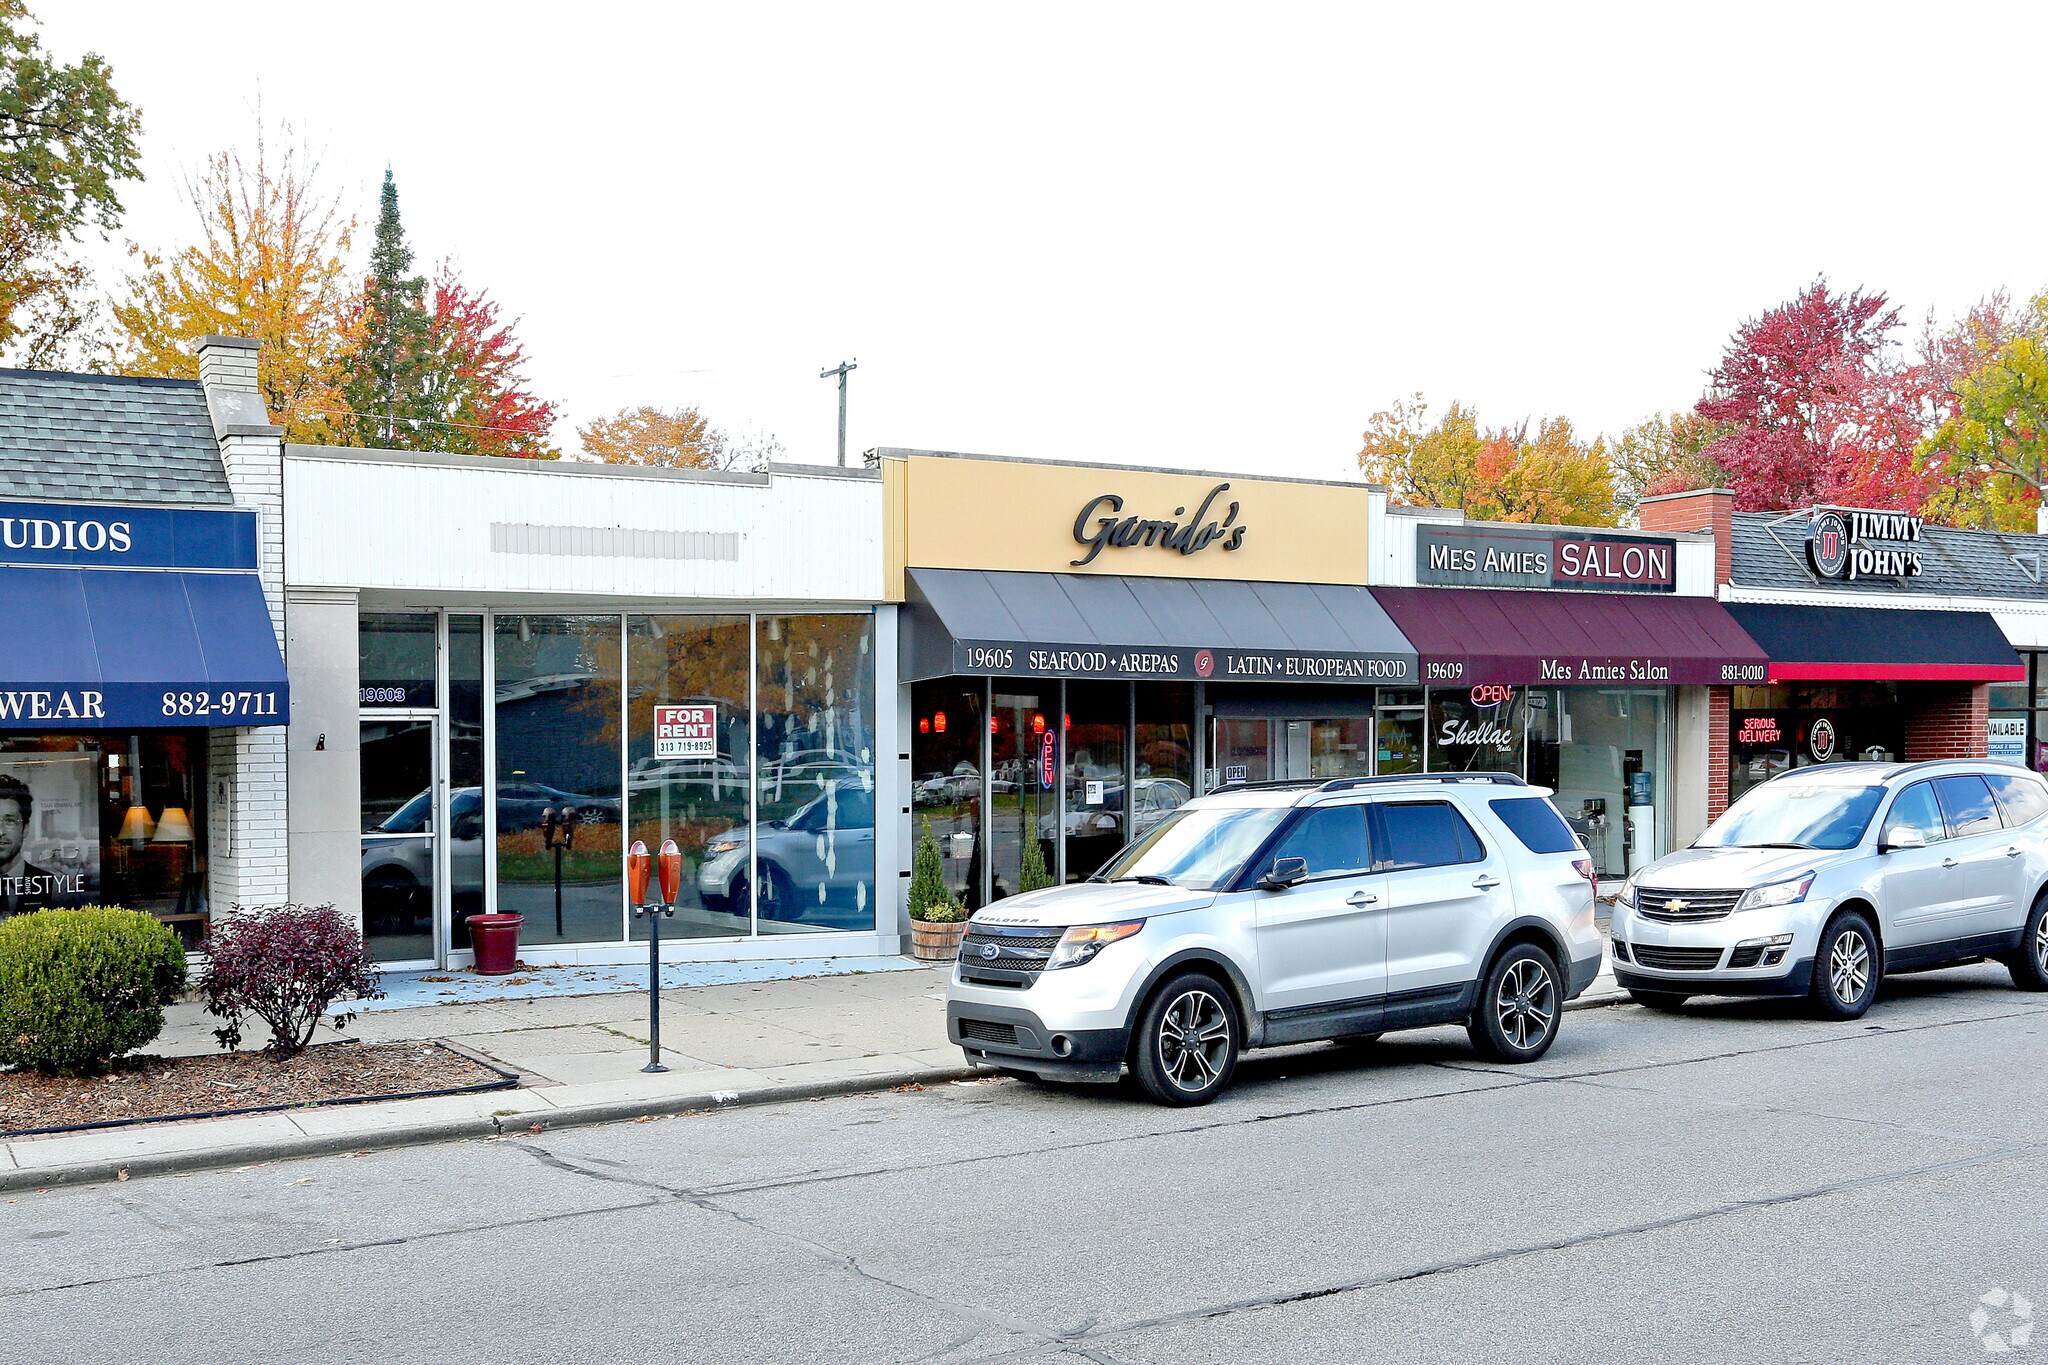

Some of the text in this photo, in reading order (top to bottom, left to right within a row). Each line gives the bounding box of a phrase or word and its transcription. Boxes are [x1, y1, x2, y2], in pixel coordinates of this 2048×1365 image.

[0, 517, 132, 552] UDIOS
[1068, 482, 1247, 566] Garrido's
[1851, 512, 1924, 544] JIMMY
[1822, 531, 1838, 560] JJ
[1561, 543, 1667, 580] SALON
[1849, 548, 1923, 580] JOHN'S
[966, 647, 1013, 669] 19605
[1028, 650, 1107, 672] SEAFOOD
[1118, 653, 1179, 673] AREPAS
[1227, 655, 1274, 675] LATIN
[1285, 657, 1364, 678] EUROPEAN
[1368, 660, 1407, 678] FOOD
[1426, 659, 1764, 680] 19609 Mes Amies Salon 881-0010
[0, 690, 278, 720] WEAR 882-9711
[359, 687, 406, 702] 19603
[1471, 684, 1512, 702] OPEN
[665, 710, 705, 723] FOR
[1744, 717, 1776, 730] SERIOUS
[659, 724, 711, 737] RENT
[1438, 719, 1513, 746] Shellac
[1739, 729, 1781, 742] DELIVERY
[660, 741, 712, 752] 313 719-8925
[1043, 731, 1054, 784] OPEN
[1227, 765, 1246, 779] OPEN
[32, 874, 85, 895] STYLE
